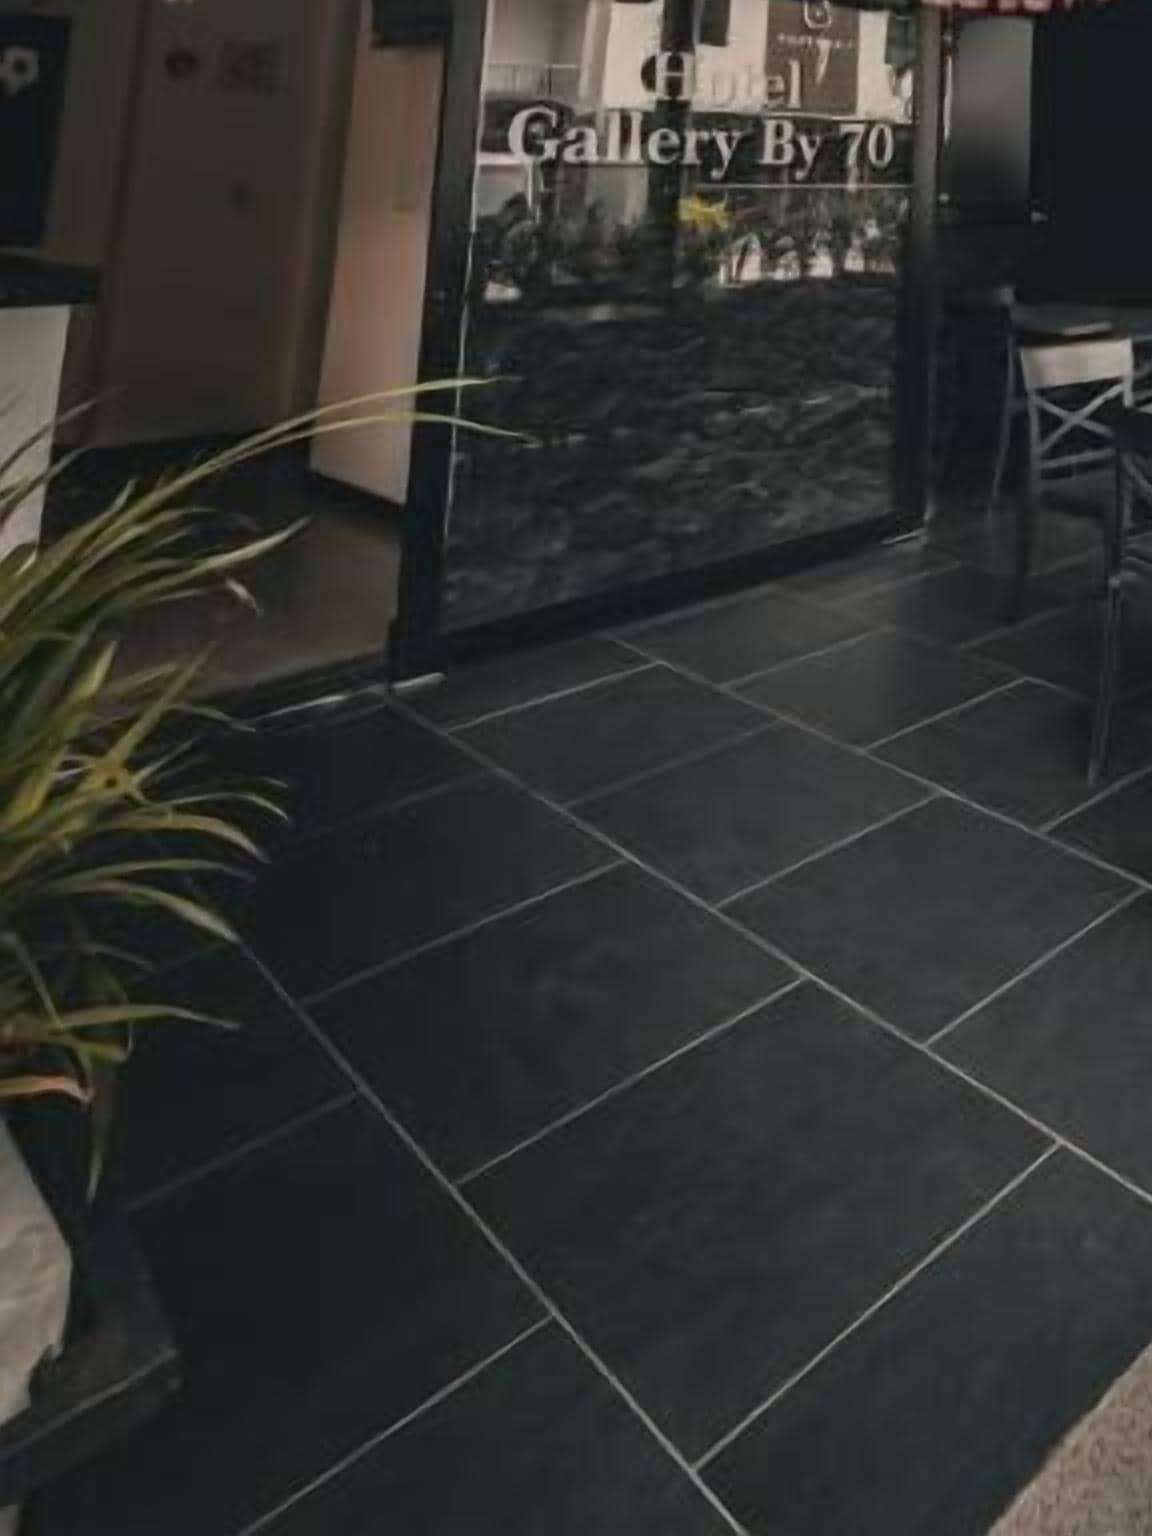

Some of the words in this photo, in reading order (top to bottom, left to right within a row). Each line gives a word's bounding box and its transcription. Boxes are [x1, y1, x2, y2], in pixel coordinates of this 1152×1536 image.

[507, 106, 742, 180] Gallery
[761, 119, 822, 180] By
[840, 123, 896, 169] 70
